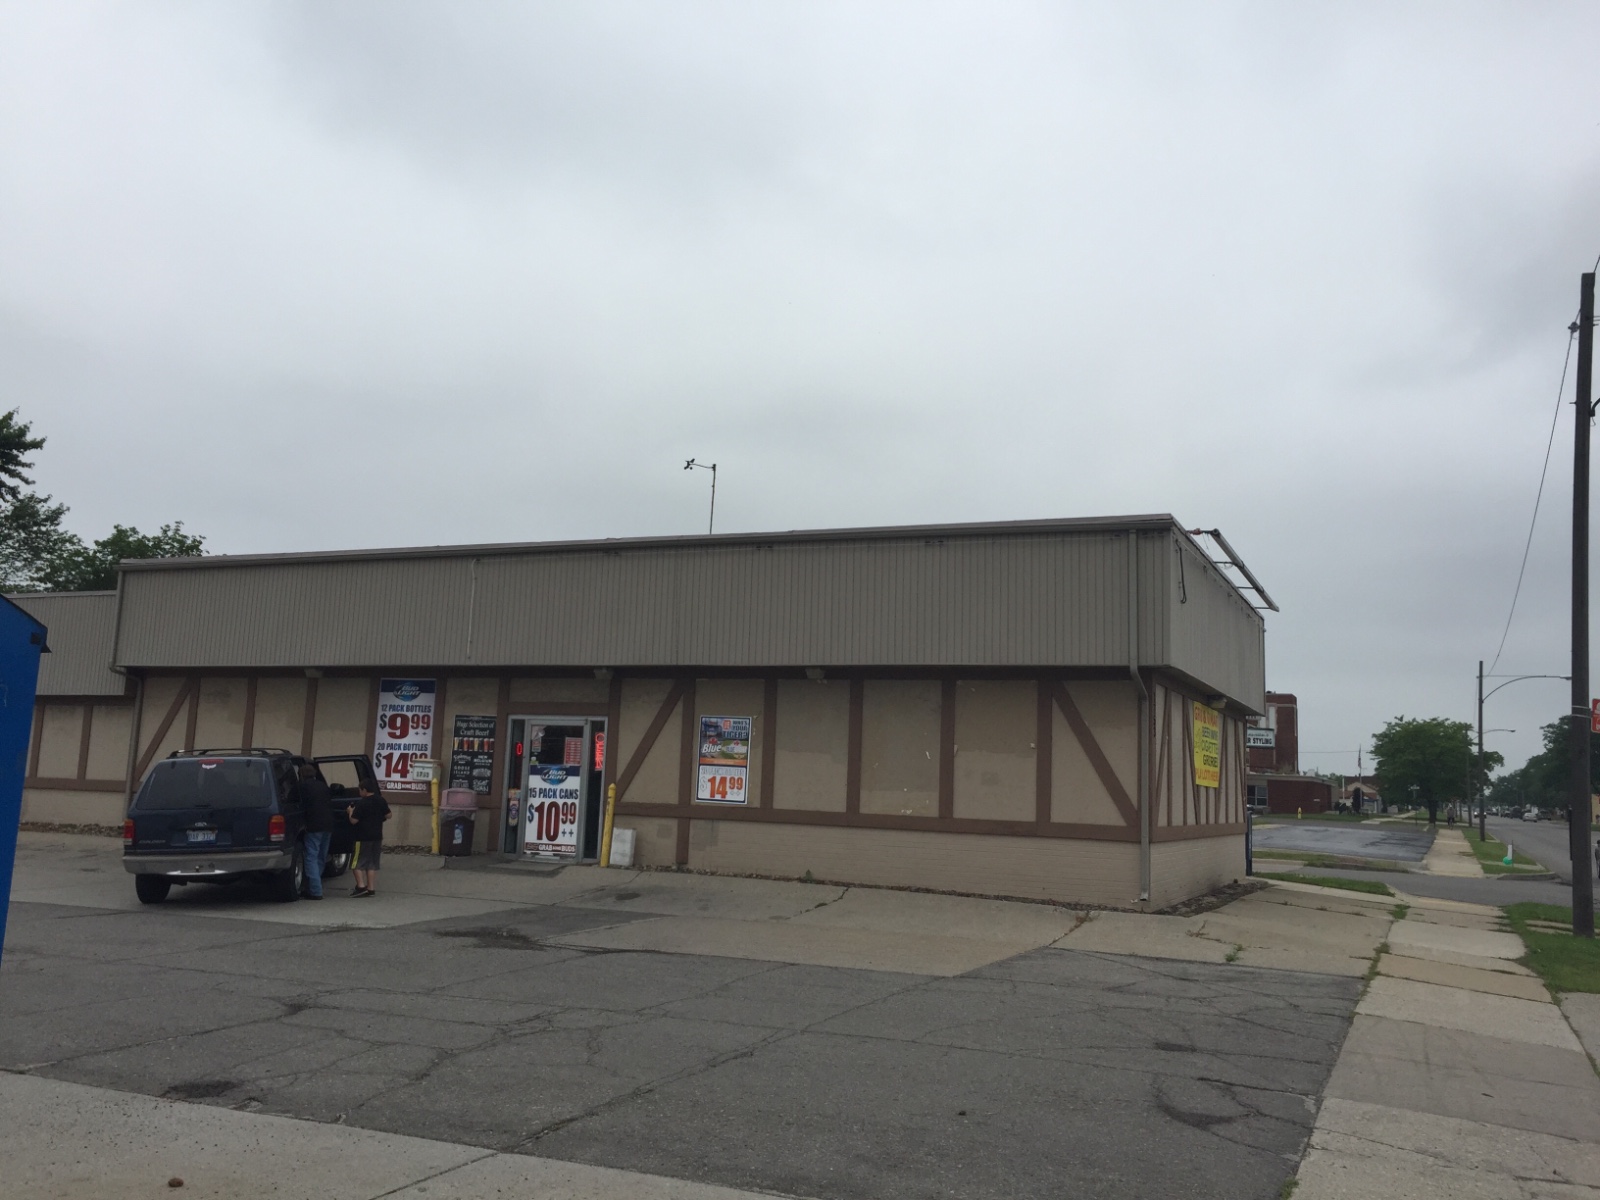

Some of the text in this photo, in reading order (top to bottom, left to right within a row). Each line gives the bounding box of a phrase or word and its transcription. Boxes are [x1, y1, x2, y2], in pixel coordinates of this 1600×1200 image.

[381, 704, 432, 713] 12 PACK BOTTLES
[1252, 737, 1273, 745] STYLING
[377, 743, 428, 752] 20 PACK BOTTLES
[702, 743, 722, 753] Blue
[386, 781, 402, 790] GRAB
[411, 782, 427, 790] BUDS
[529, 787, 579, 800] 15 PACK CANS
